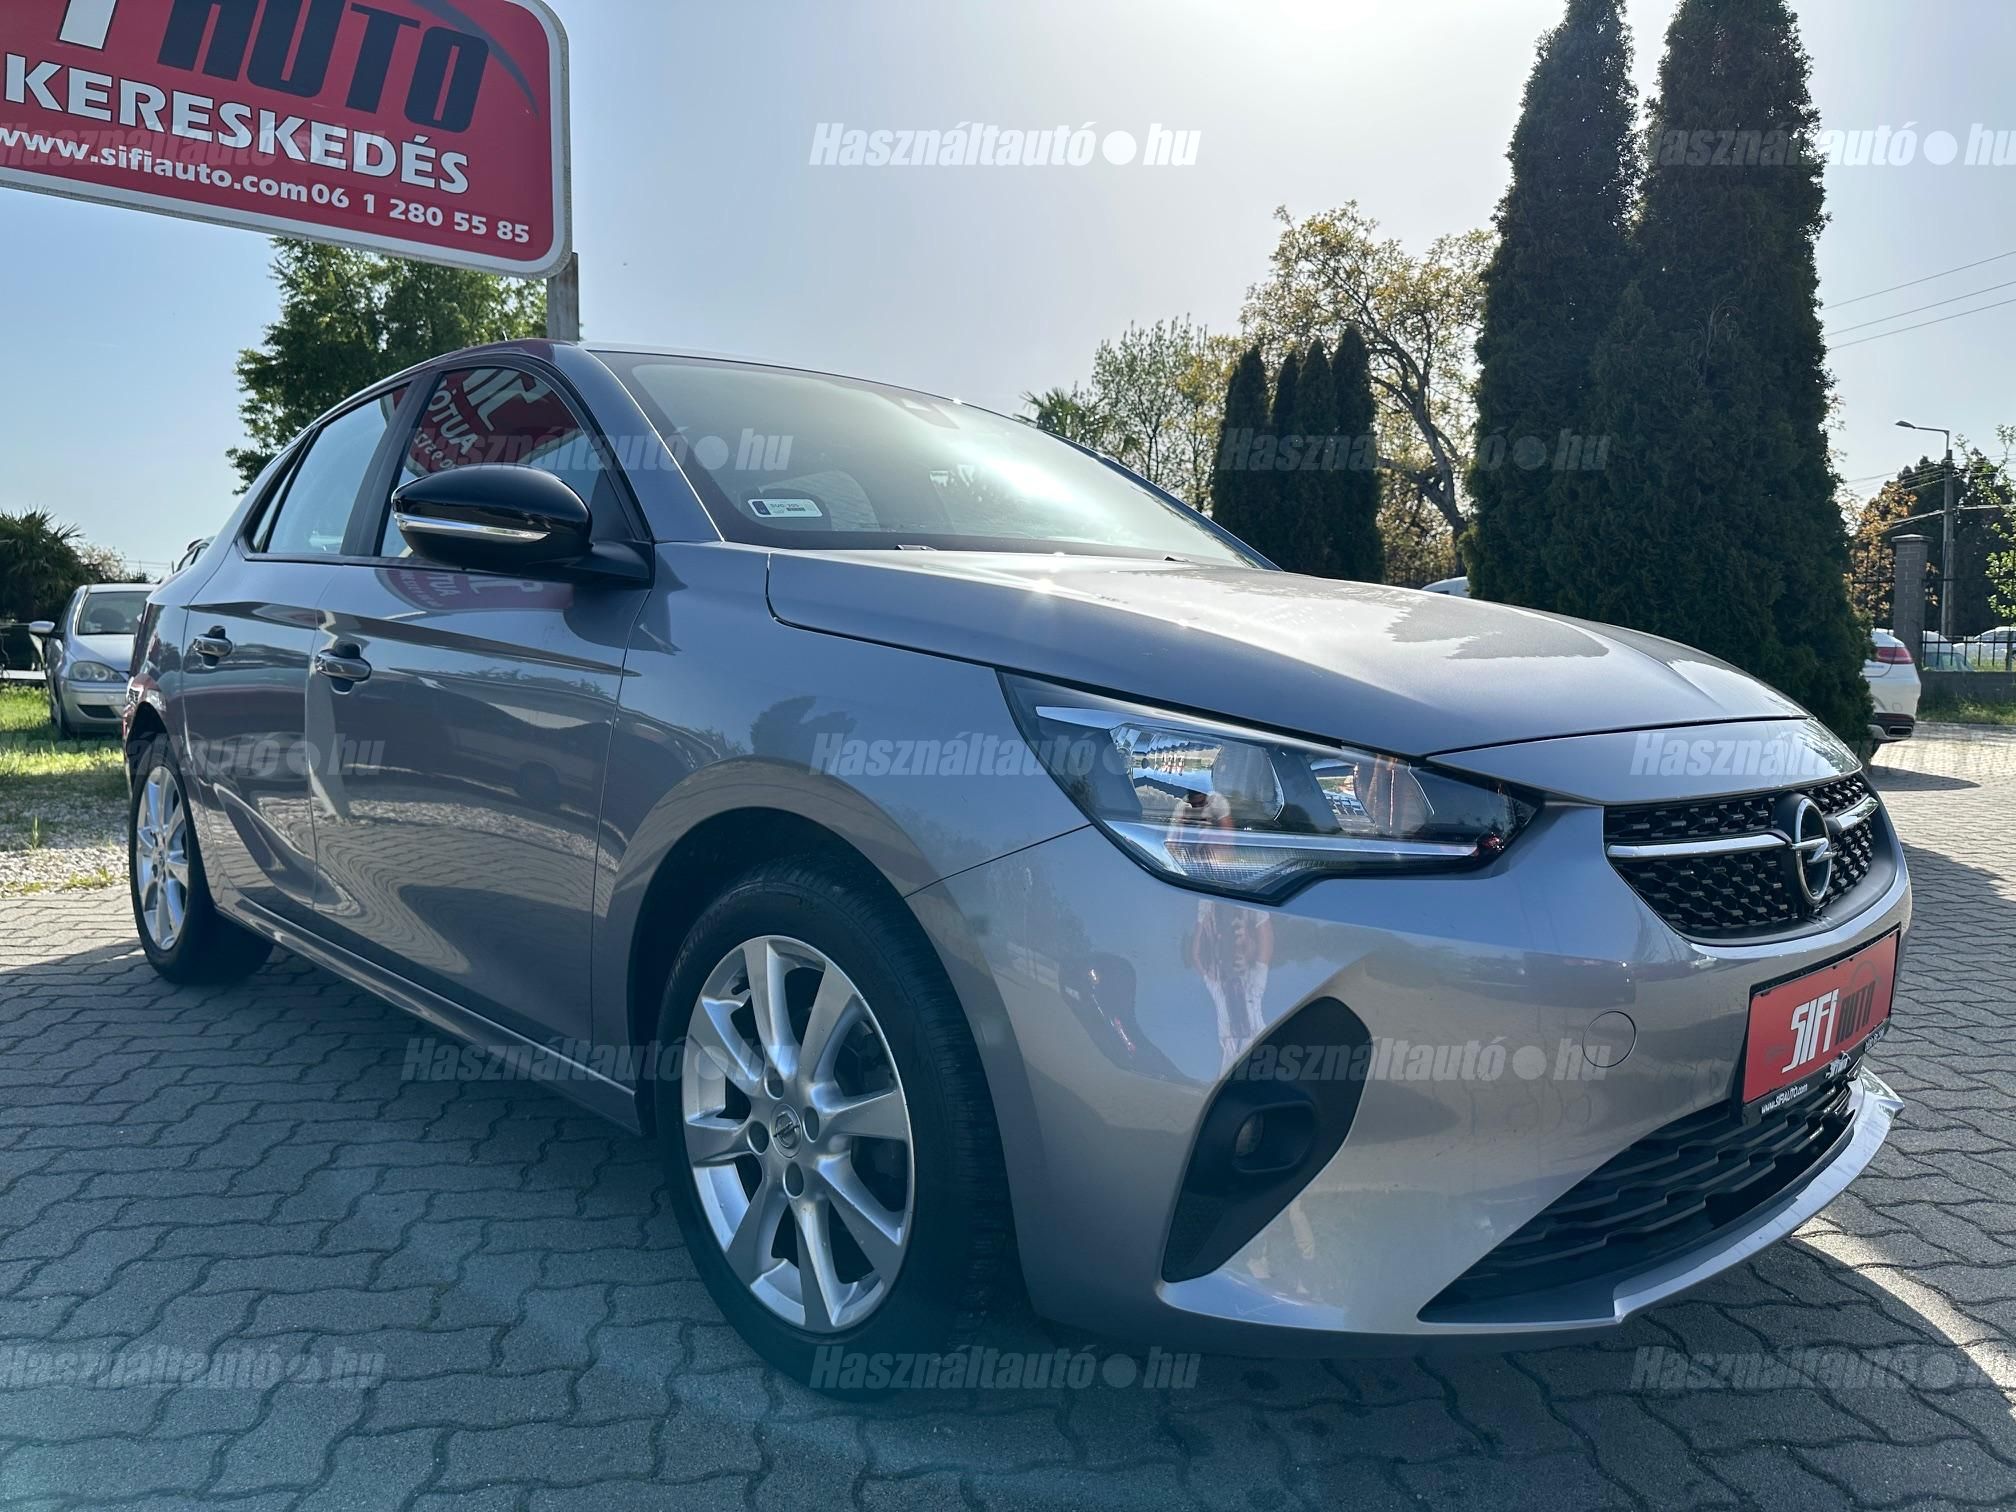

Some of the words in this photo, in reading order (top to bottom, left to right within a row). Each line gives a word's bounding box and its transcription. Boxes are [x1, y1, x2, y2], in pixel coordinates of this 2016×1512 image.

[4, 52, 470, 195] KERESKEDÉS
[157, 0, 490, 134] AUTO
[310, 183, 350, 209] 06
[363, 193, 376, 214] 1
[389, 199, 443, 227] 280
[454, 211, 487, 236] 55
[496, 221, 530, 244] 85
